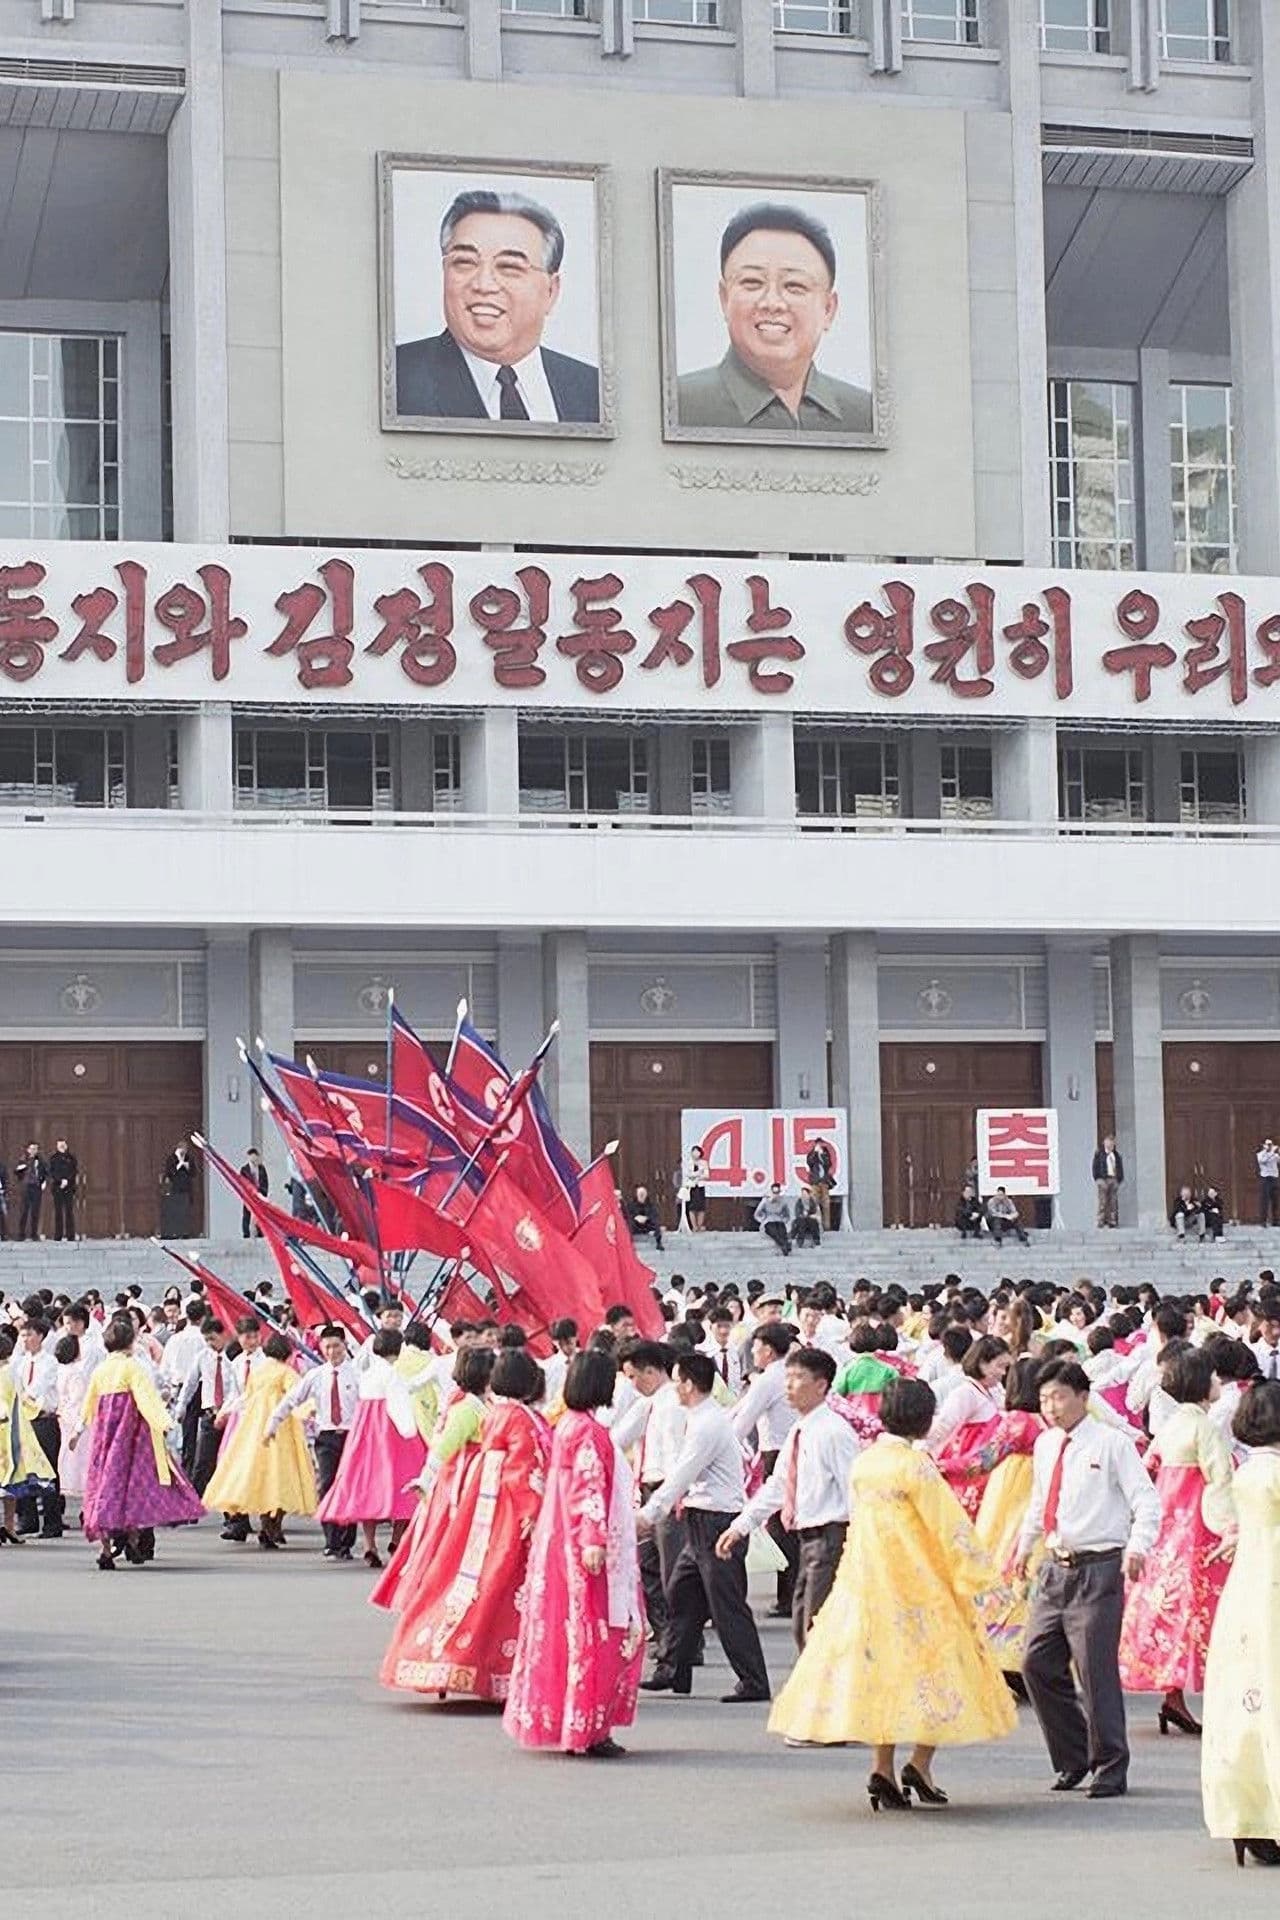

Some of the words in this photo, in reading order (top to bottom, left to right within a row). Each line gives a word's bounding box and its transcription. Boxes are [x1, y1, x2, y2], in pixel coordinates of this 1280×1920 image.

[0, 560, 248, 683] 동지와
[264, 559, 805, 694] 김정일동지는
[845, 580, 1072, 700] 영원히
[702, 1117, 838, 1188] 4.15
[988, 1113, 1050, 1188] 축
